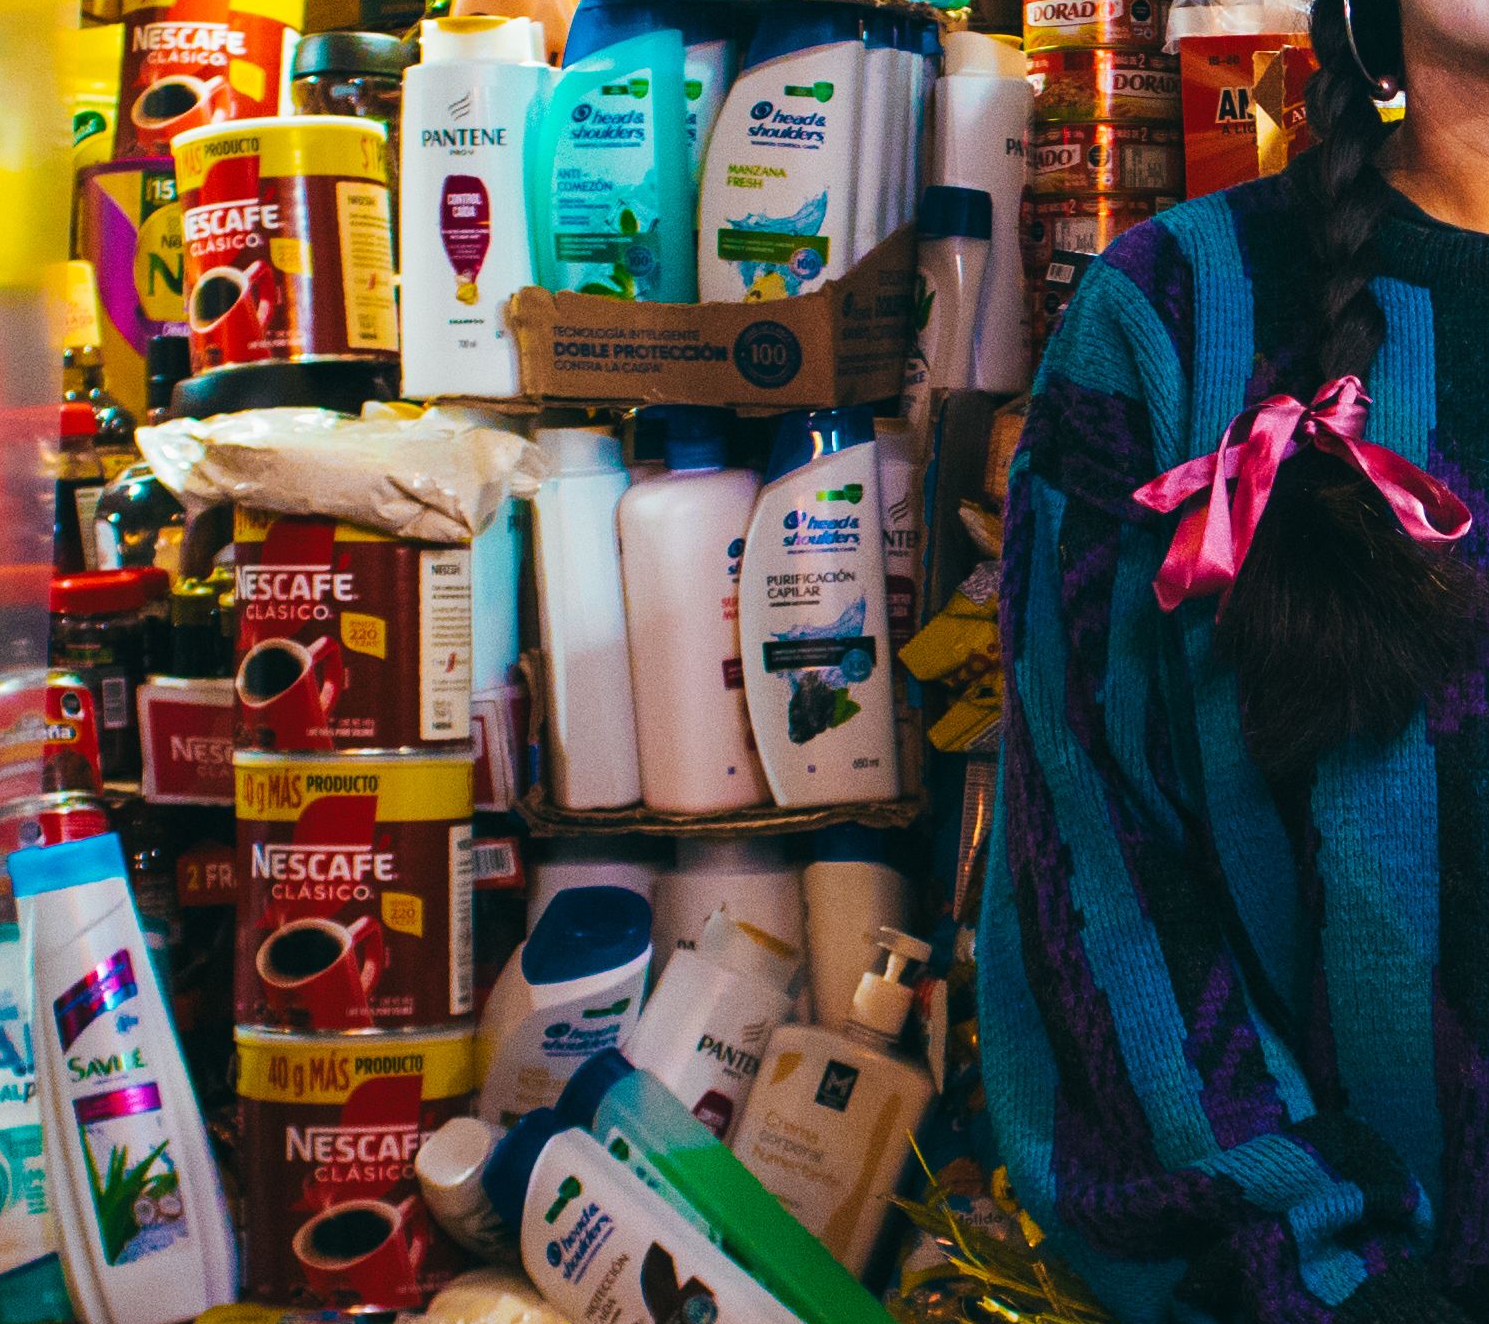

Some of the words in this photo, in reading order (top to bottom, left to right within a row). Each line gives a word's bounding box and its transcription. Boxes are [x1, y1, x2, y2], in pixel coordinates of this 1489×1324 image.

[592, 108, 646, 129] head&
[773, 110, 825, 129] head&
[421, 128, 507, 148] PANTENE
[571, 122, 645, 142] shoulders
[747, 122, 824, 144] shoulders
[203, 137, 260, 158] PRODUCTO
[727, 164, 786, 179] MANZANA
[726, 176, 764, 191] FRESH
[554, 343, 609, 359] DOBLE
[613, 343, 727, 363] PROTECCIÓN
[752, 343, 787, 367] 100
[553, 360, 602, 374] CONTRA
[809, 513, 860, 531] head&
[782, 527, 860, 546] shoulders
[767, 569, 857, 586] PURIFICACIÓN
[767, 583, 821, 600] CAPILAR
[305, 775, 380, 796] PRODUCTO
[270, 880, 373, 903] CLÁSICO
[286, 1125, 427, 1164] NESCAF
